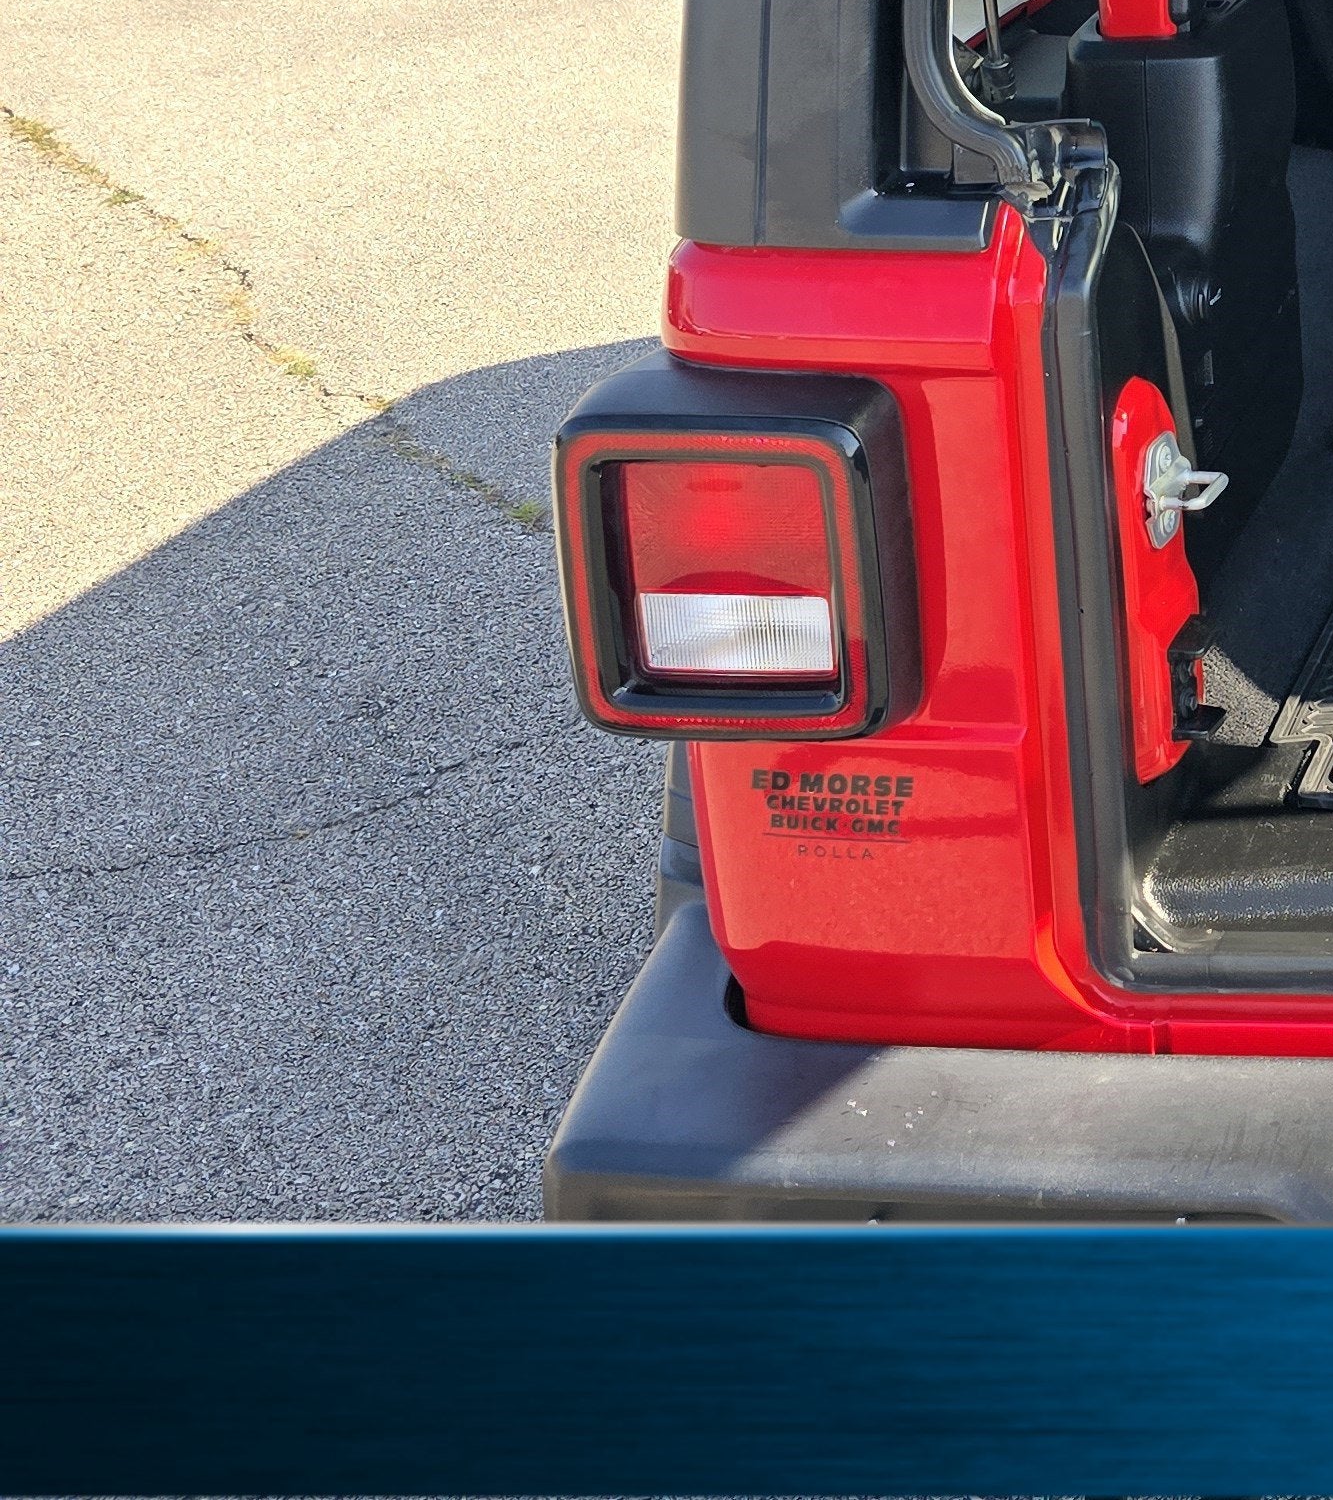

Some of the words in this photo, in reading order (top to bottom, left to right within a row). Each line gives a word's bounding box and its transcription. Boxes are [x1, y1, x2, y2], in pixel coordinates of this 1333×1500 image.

[750, 768, 792, 791] ED
[798, 771, 915, 799] MORSE
[766, 794, 905, 816] CHEVROLET
[770, 813, 839, 832] BUICK
[797, 844, 875, 861] ROLLA
